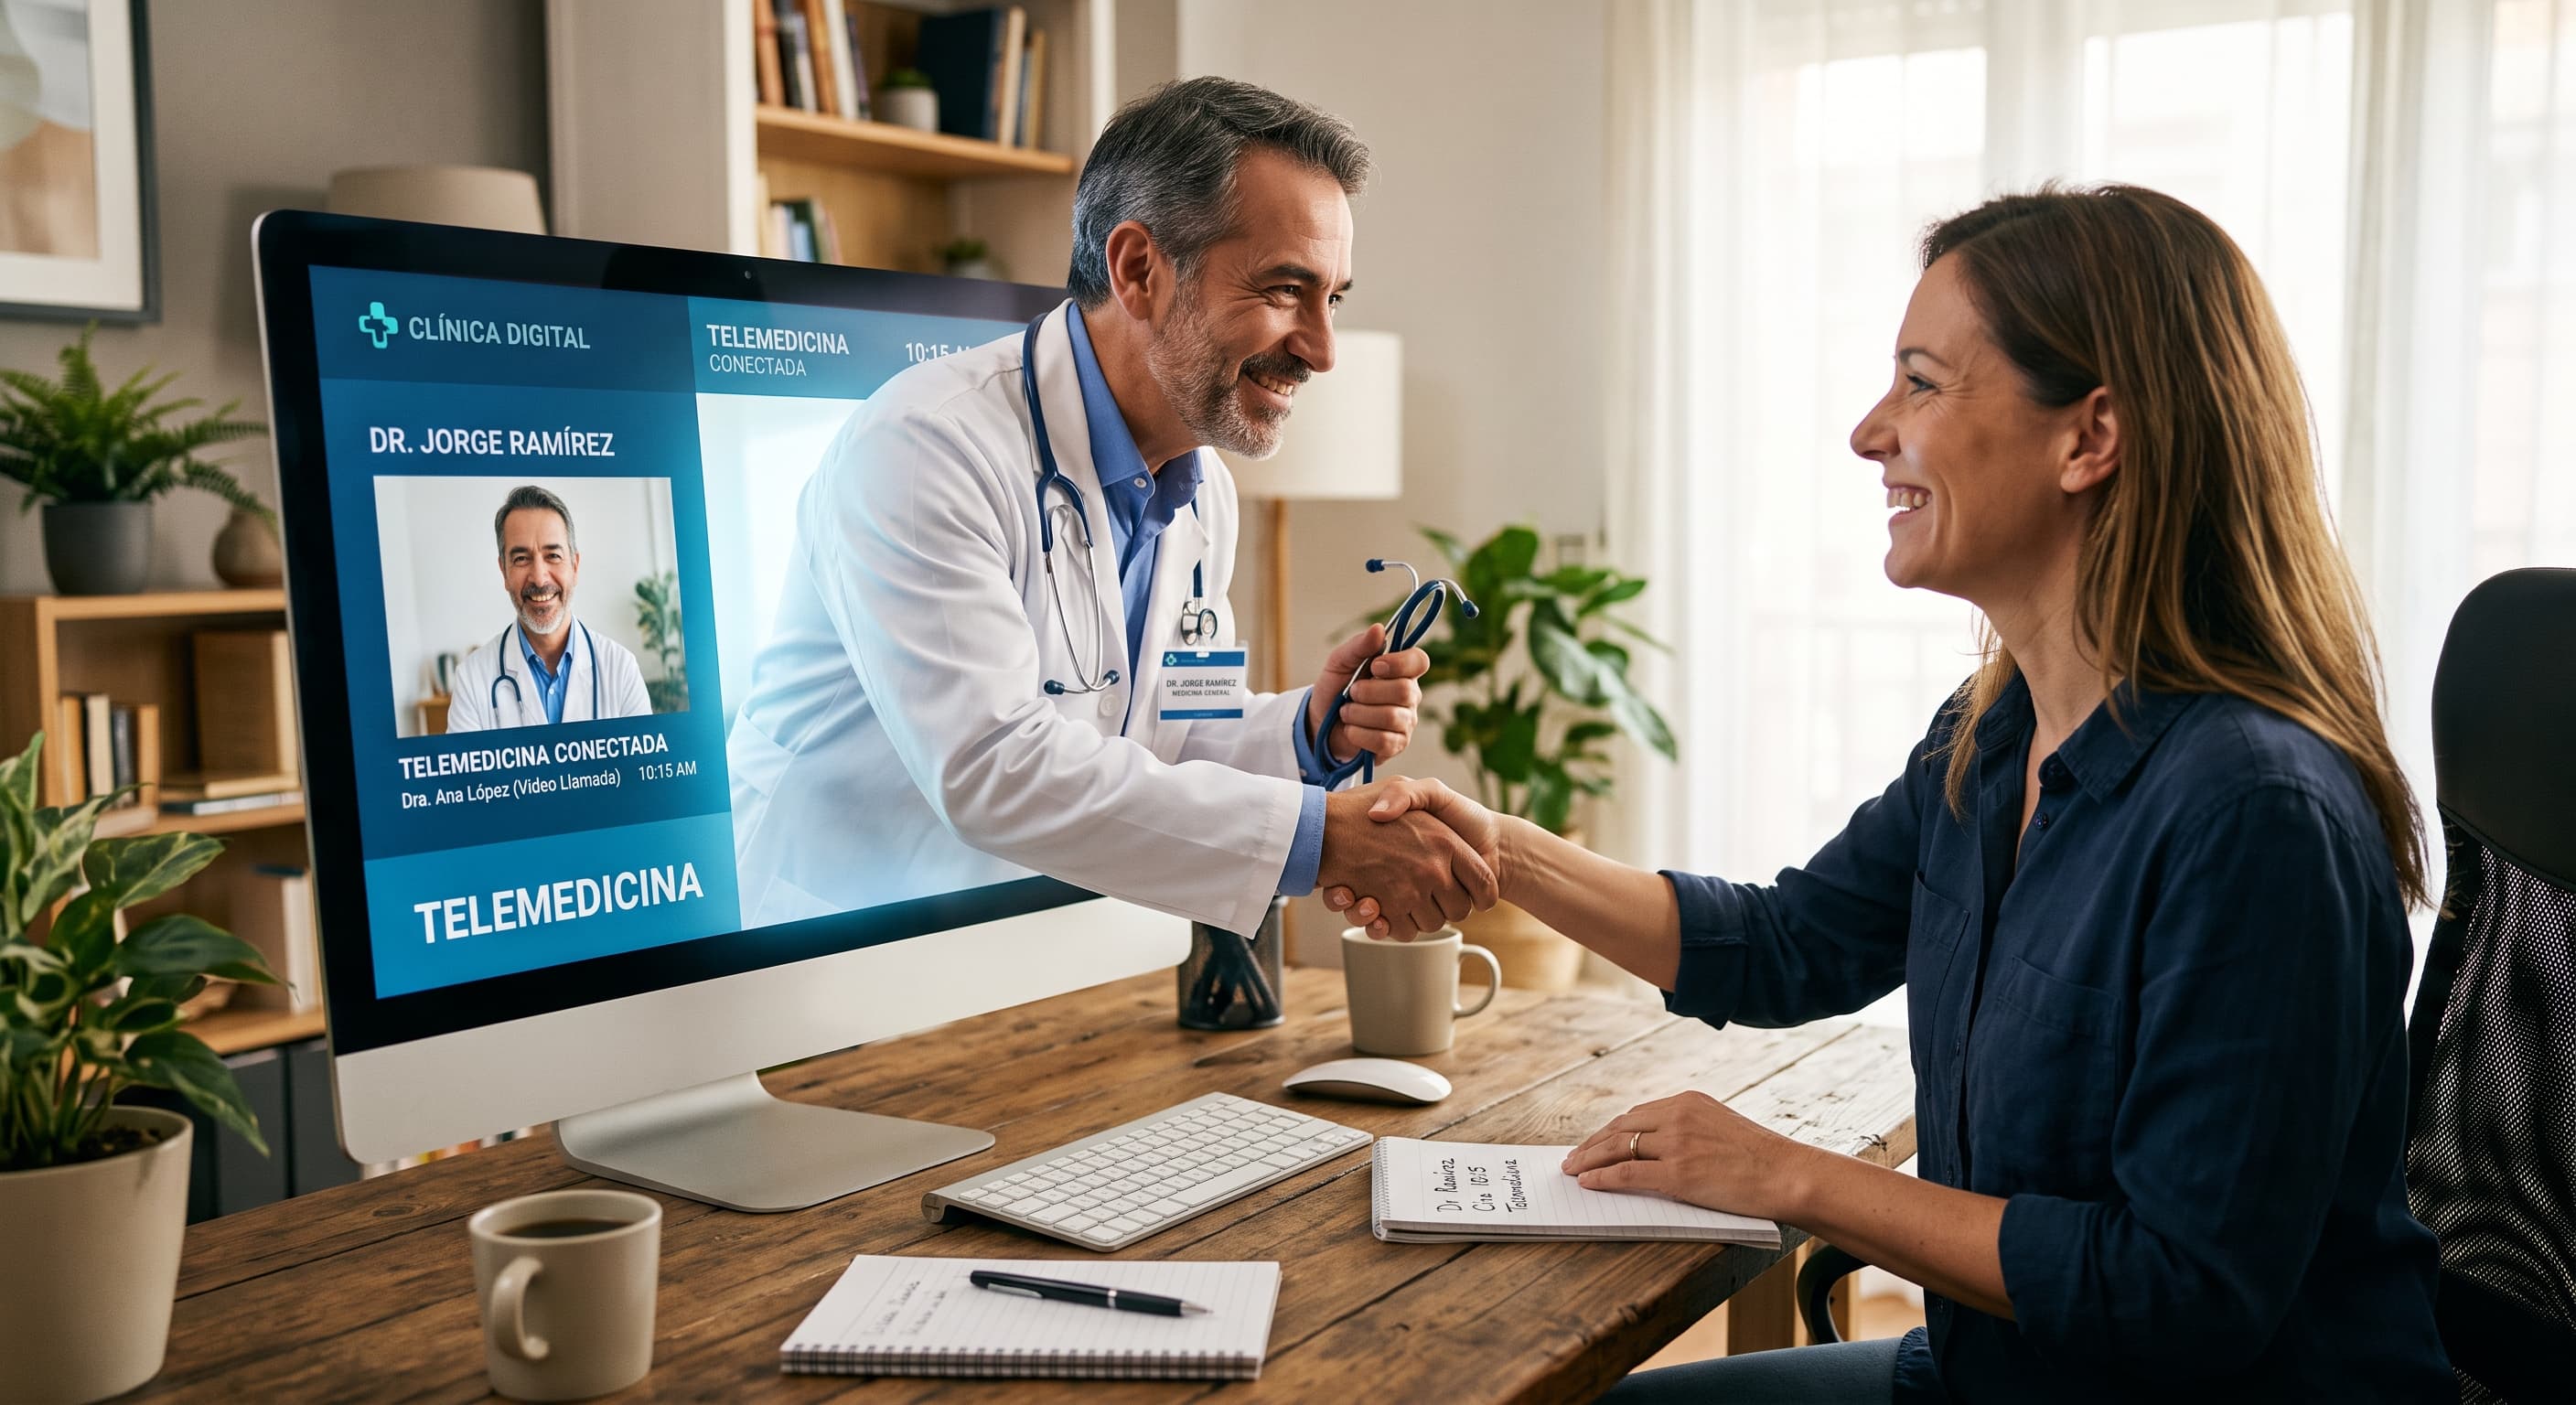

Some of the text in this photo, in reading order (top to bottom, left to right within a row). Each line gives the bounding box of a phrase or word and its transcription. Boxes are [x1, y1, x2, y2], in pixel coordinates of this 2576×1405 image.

[409, 313, 591, 349] CLÍNICA DIGITAL
[706, 324, 850, 355] TELEMEDICINA
[709, 354, 807, 377] CONECTADA
[370, 426, 616, 456] DR. JORGE RAMÍREZ
[1166, 680, 1179, 688] DR.
[1180, 679, 1204, 688] JORGE
[398, 733, 669, 779] TELEMEDICINA CONECTADA
[402, 760, 697, 809] Dra. Ana López (Video Llamada) 10:15 AM
[413, 862, 704, 944] TELEMEDICINA
